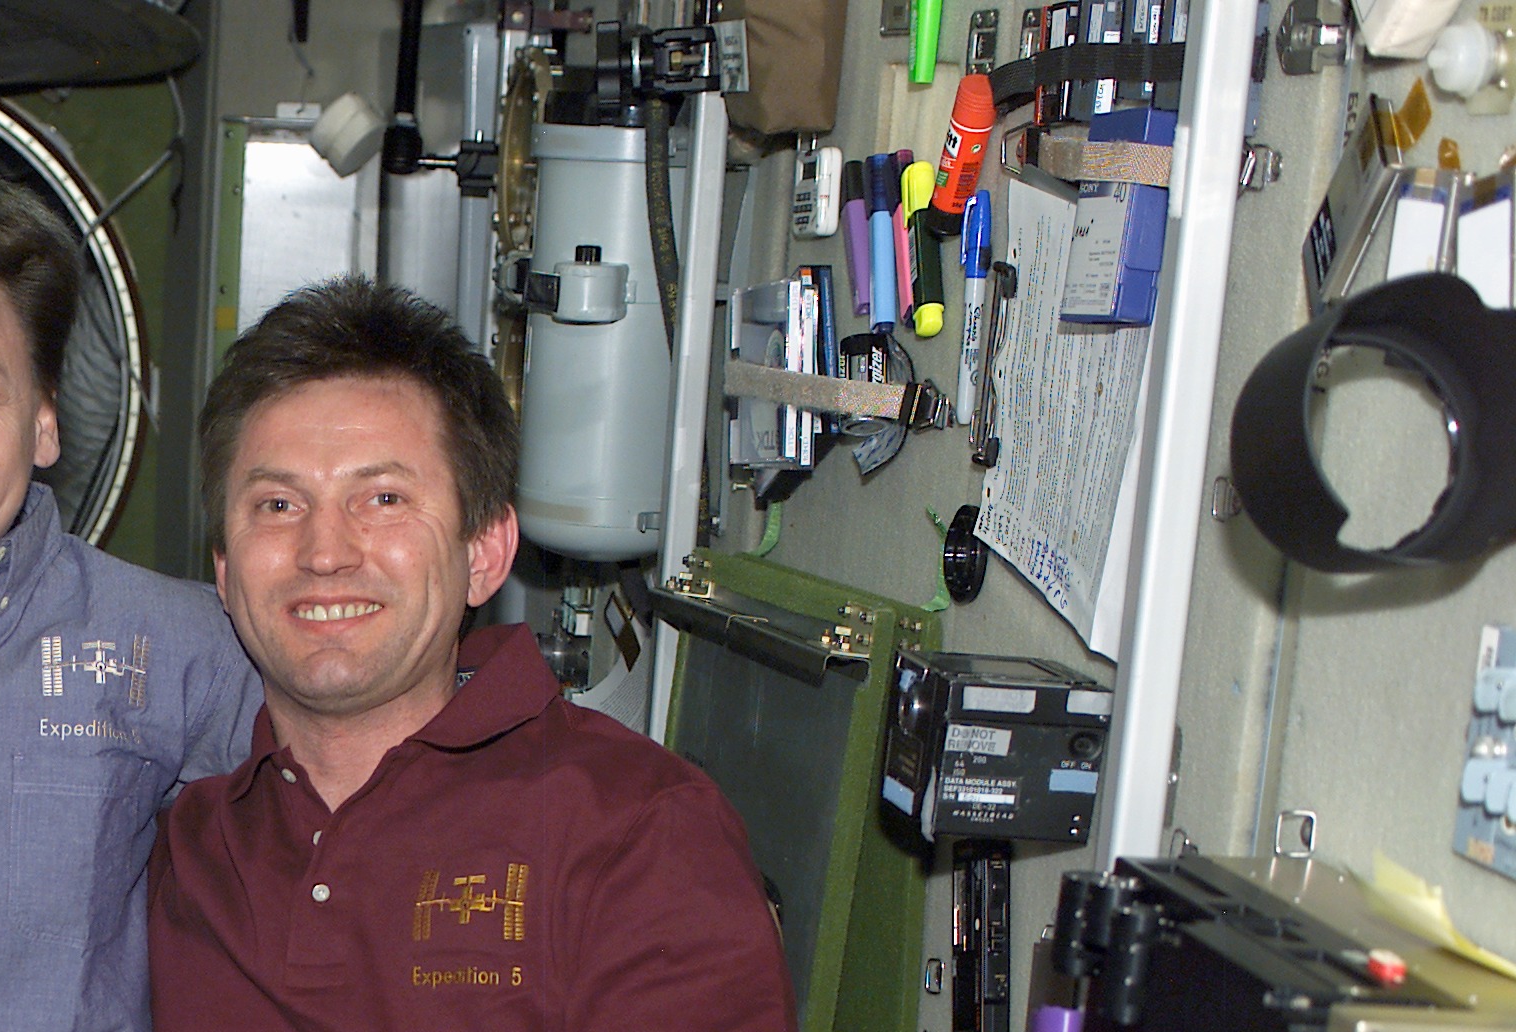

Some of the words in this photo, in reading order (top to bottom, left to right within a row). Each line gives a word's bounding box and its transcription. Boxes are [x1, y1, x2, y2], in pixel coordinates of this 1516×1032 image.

[1079, 183, 1100, 194] SONY
[40, 718, 127, 741] Expedition
[971, 729, 996, 740] NOT
[1060, 760, 1076, 769] OFF
[1080, 761, 1093, 770] ON
[944, 777, 964, 786] DATA
[965, 778, 996, 787] MODULE
[412, 965, 500, 990] Expedition
[511, 966, 522, 986] 5
